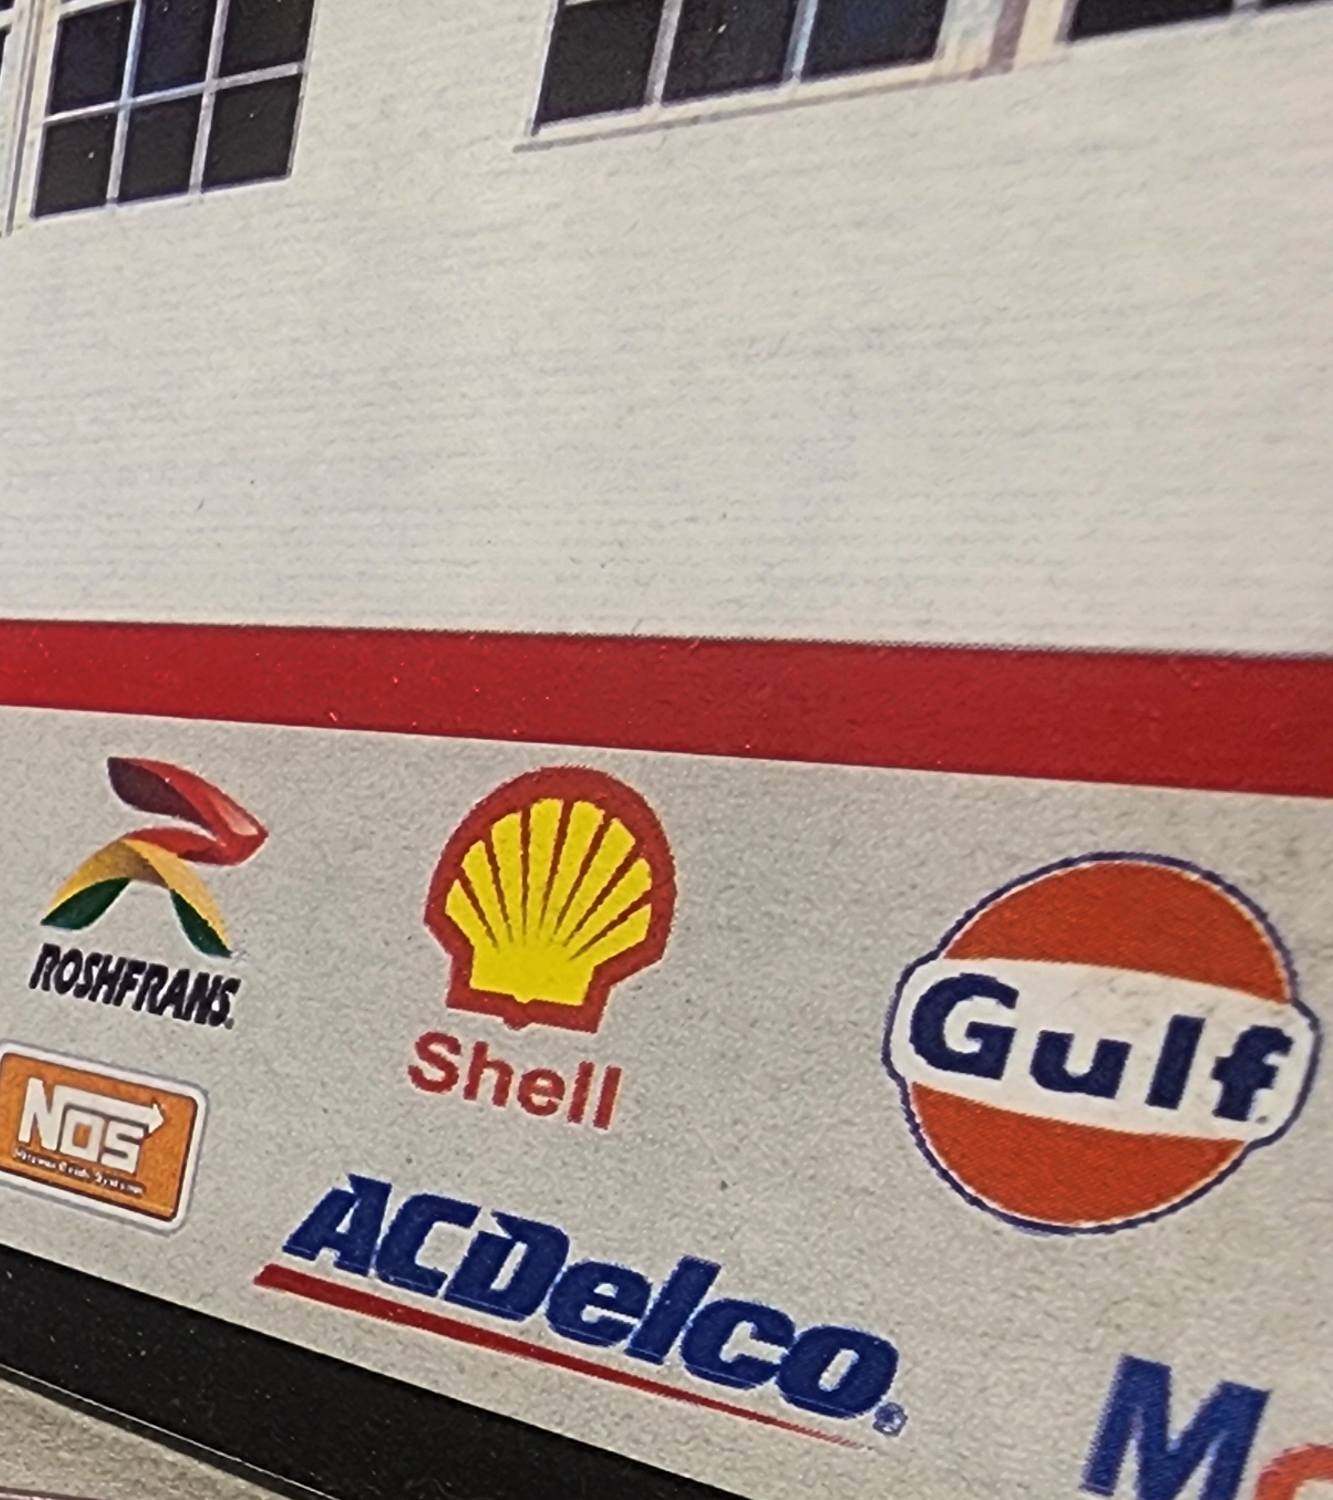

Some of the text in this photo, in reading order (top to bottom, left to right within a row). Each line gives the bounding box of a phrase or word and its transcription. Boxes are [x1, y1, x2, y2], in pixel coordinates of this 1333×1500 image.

[407, 1031, 623, 1130] Shell
[910, 973, 1294, 1122] Gulf
[18, 1077, 164, 1174] NOS
[281, 1173, 899, 1420] ACDelco
